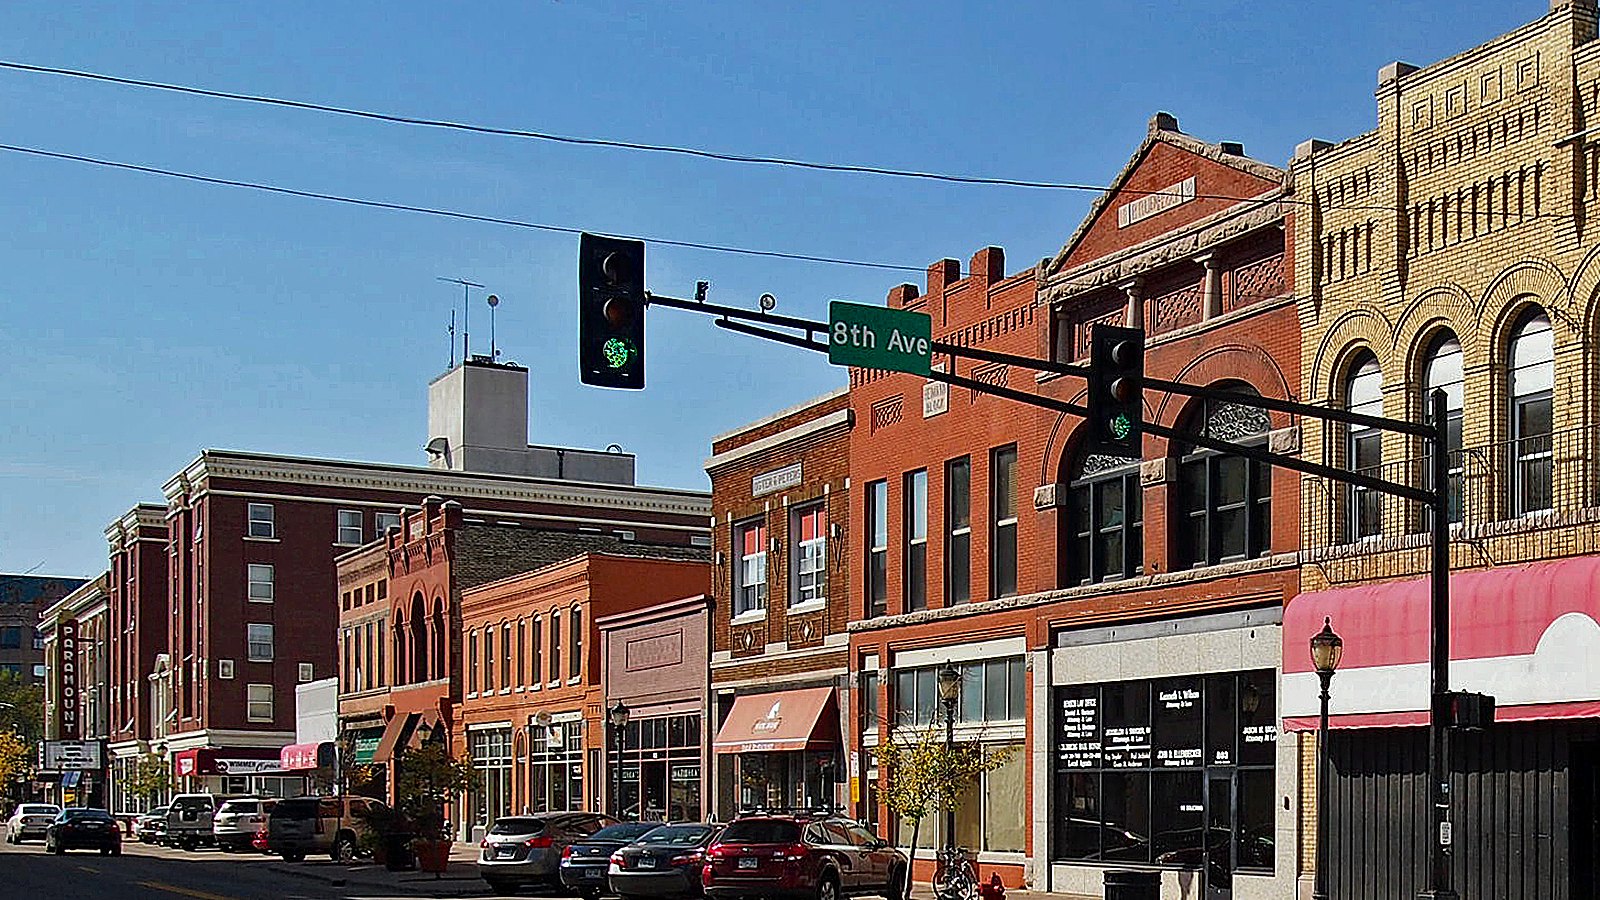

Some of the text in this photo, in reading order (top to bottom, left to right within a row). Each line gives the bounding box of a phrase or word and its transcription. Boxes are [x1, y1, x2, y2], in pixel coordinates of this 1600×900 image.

[834, 322, 928, 355] 8th Ave
[63, 626, 75, 733] PARAMOUNT
